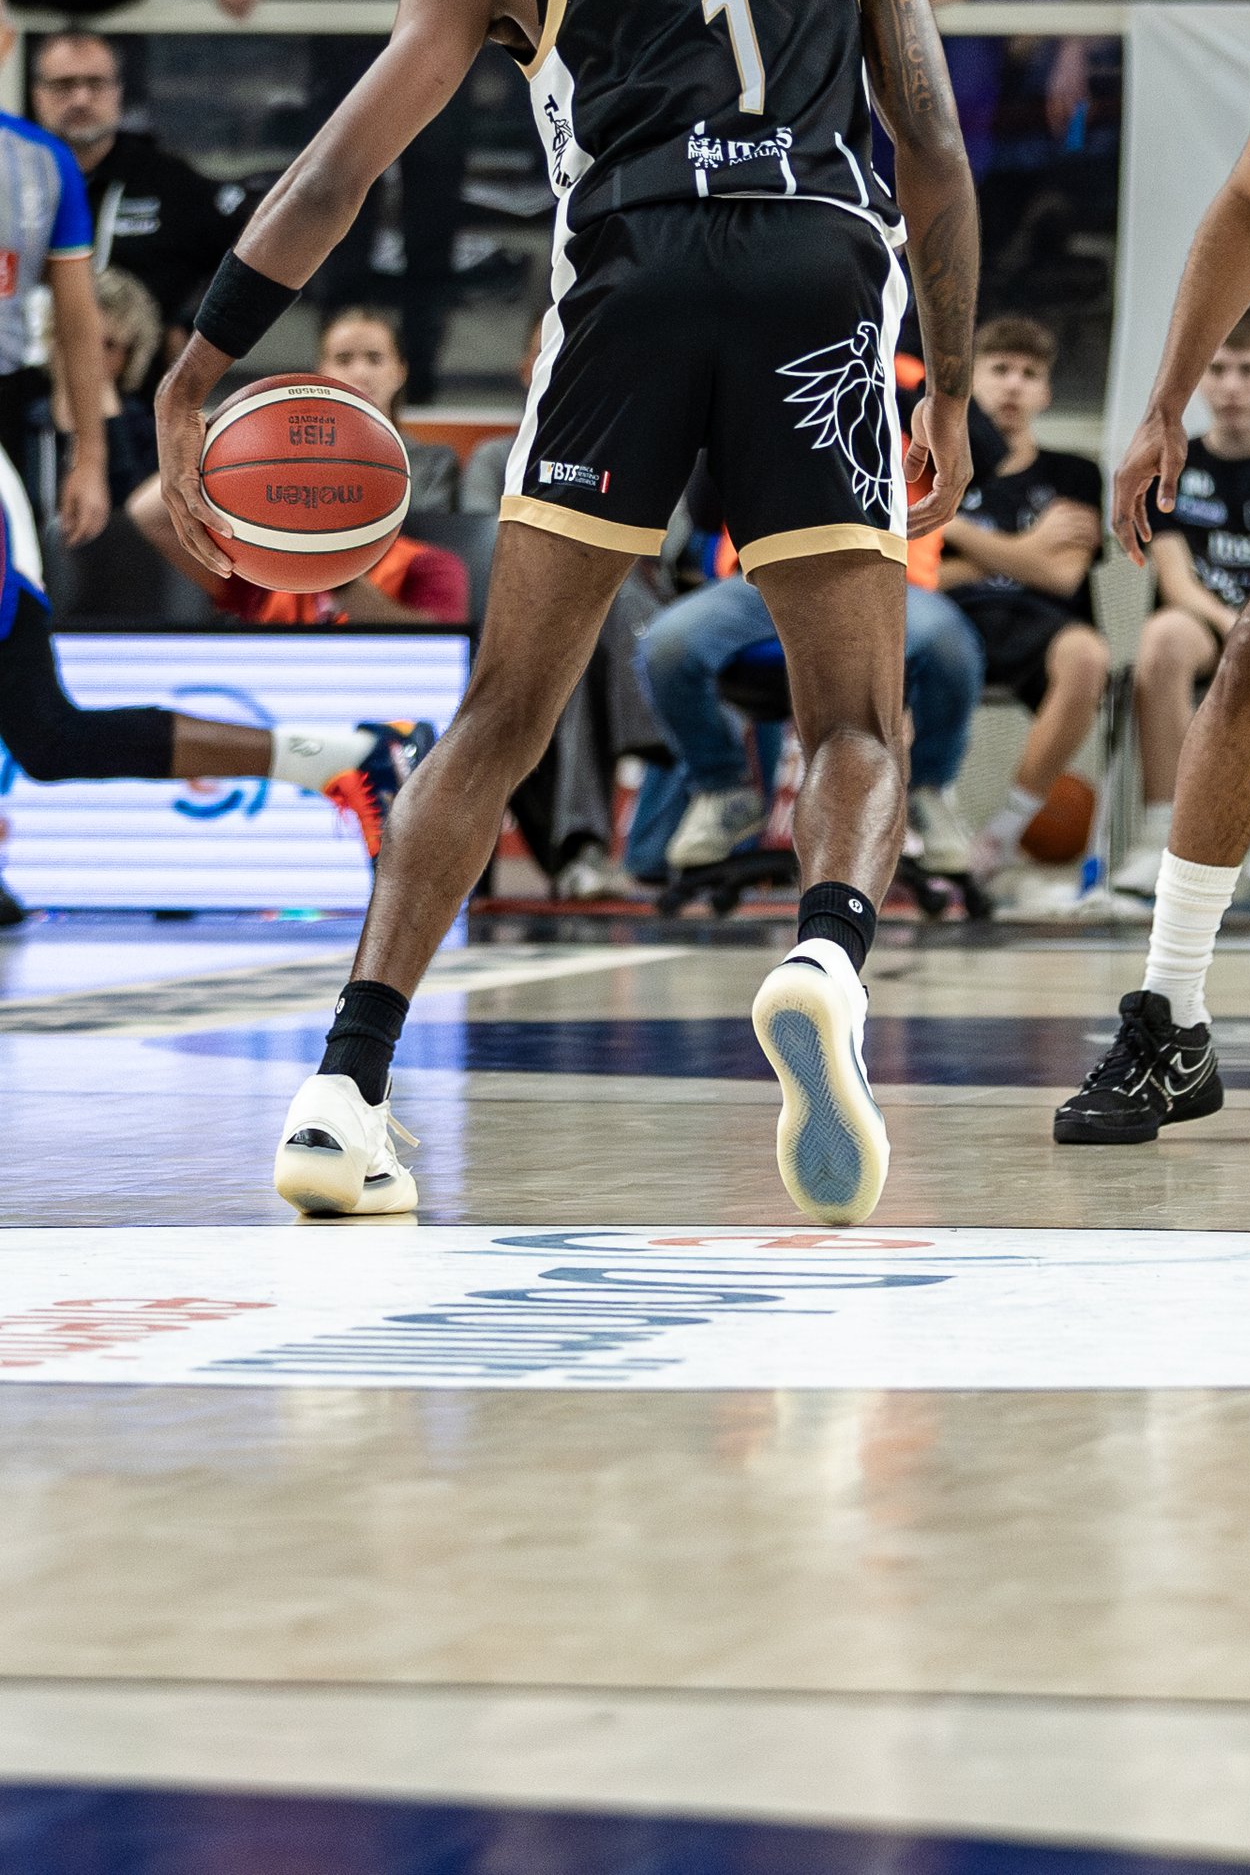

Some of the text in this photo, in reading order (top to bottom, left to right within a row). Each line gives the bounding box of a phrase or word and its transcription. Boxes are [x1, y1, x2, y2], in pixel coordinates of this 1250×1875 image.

[288, 415, 336, 425] APPROVED
[289, 425, 337, 447] FIBA
[554, 461, 580, 482] BTS
[265, 484, 363, 509] molten
